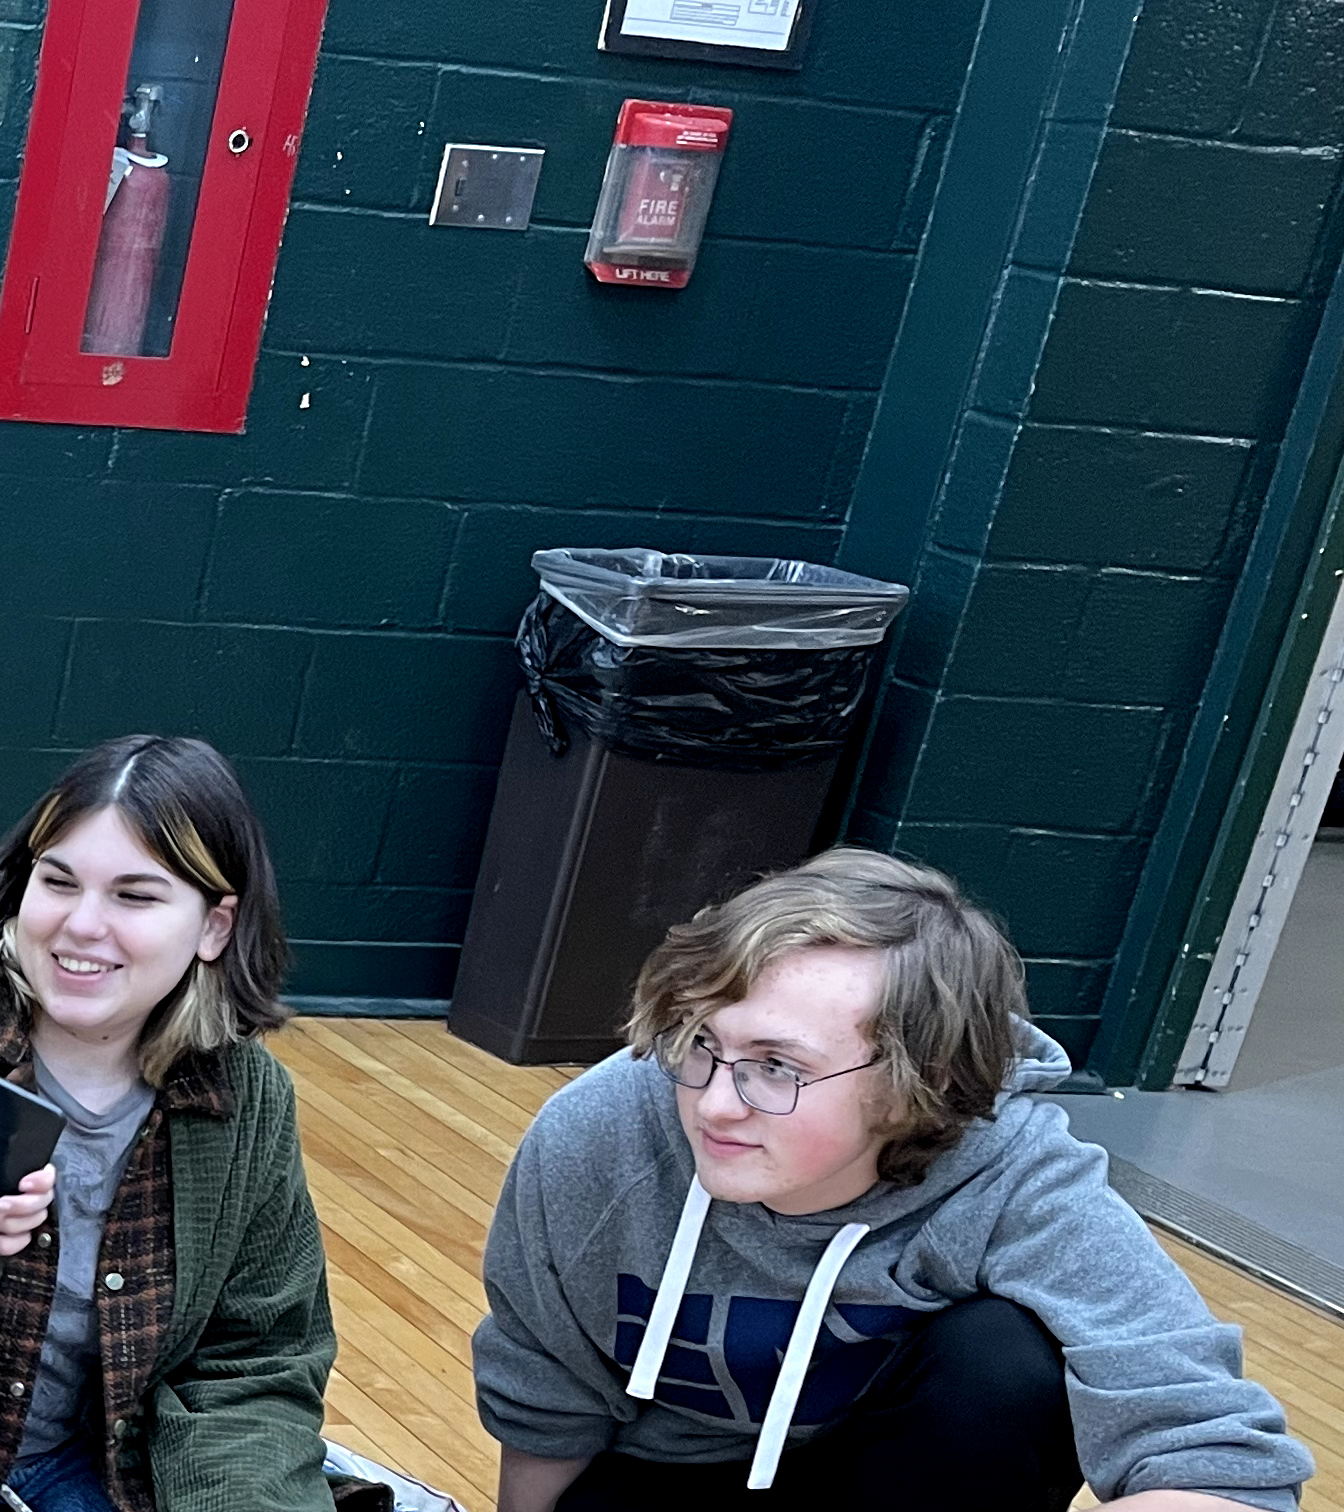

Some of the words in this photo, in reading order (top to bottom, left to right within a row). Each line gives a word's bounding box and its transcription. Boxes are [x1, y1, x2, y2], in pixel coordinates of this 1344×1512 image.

[639, 199, 680, 215] FIRE
[636, 214, 676, 226] ALARM
[615, 268, 638, 280] LIFT
